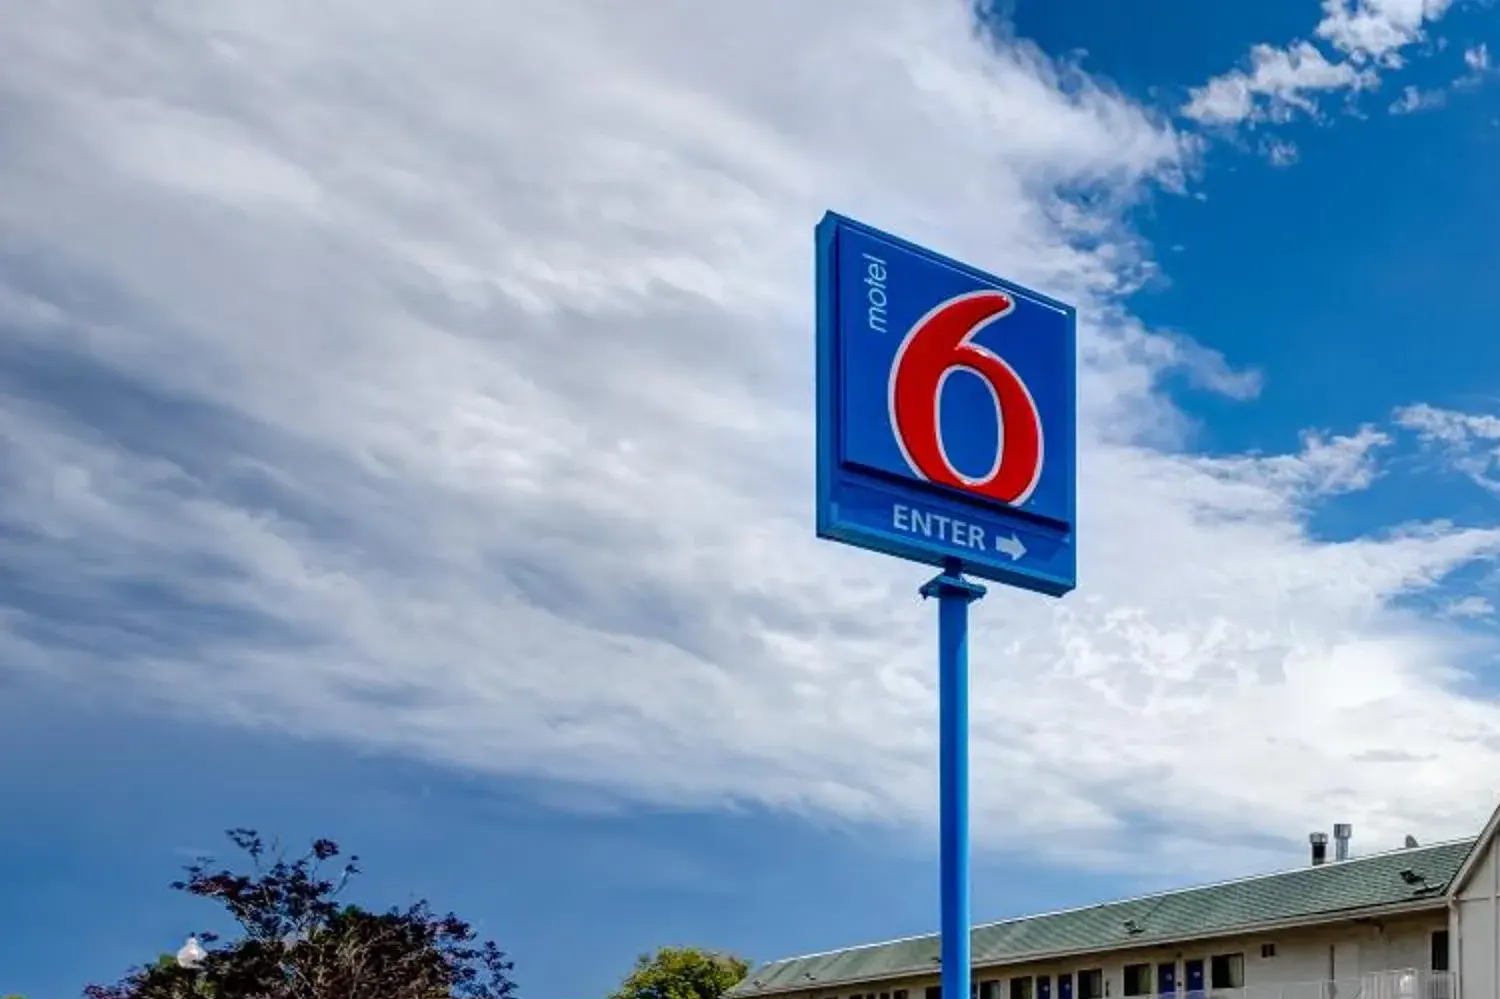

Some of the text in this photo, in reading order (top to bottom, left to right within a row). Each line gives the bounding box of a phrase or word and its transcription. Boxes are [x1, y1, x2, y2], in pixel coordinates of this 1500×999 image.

[862, 253, 887, 333] motel
[888, 289, 1044, 507] 6
[893, 505, 986, 551] ENTER
